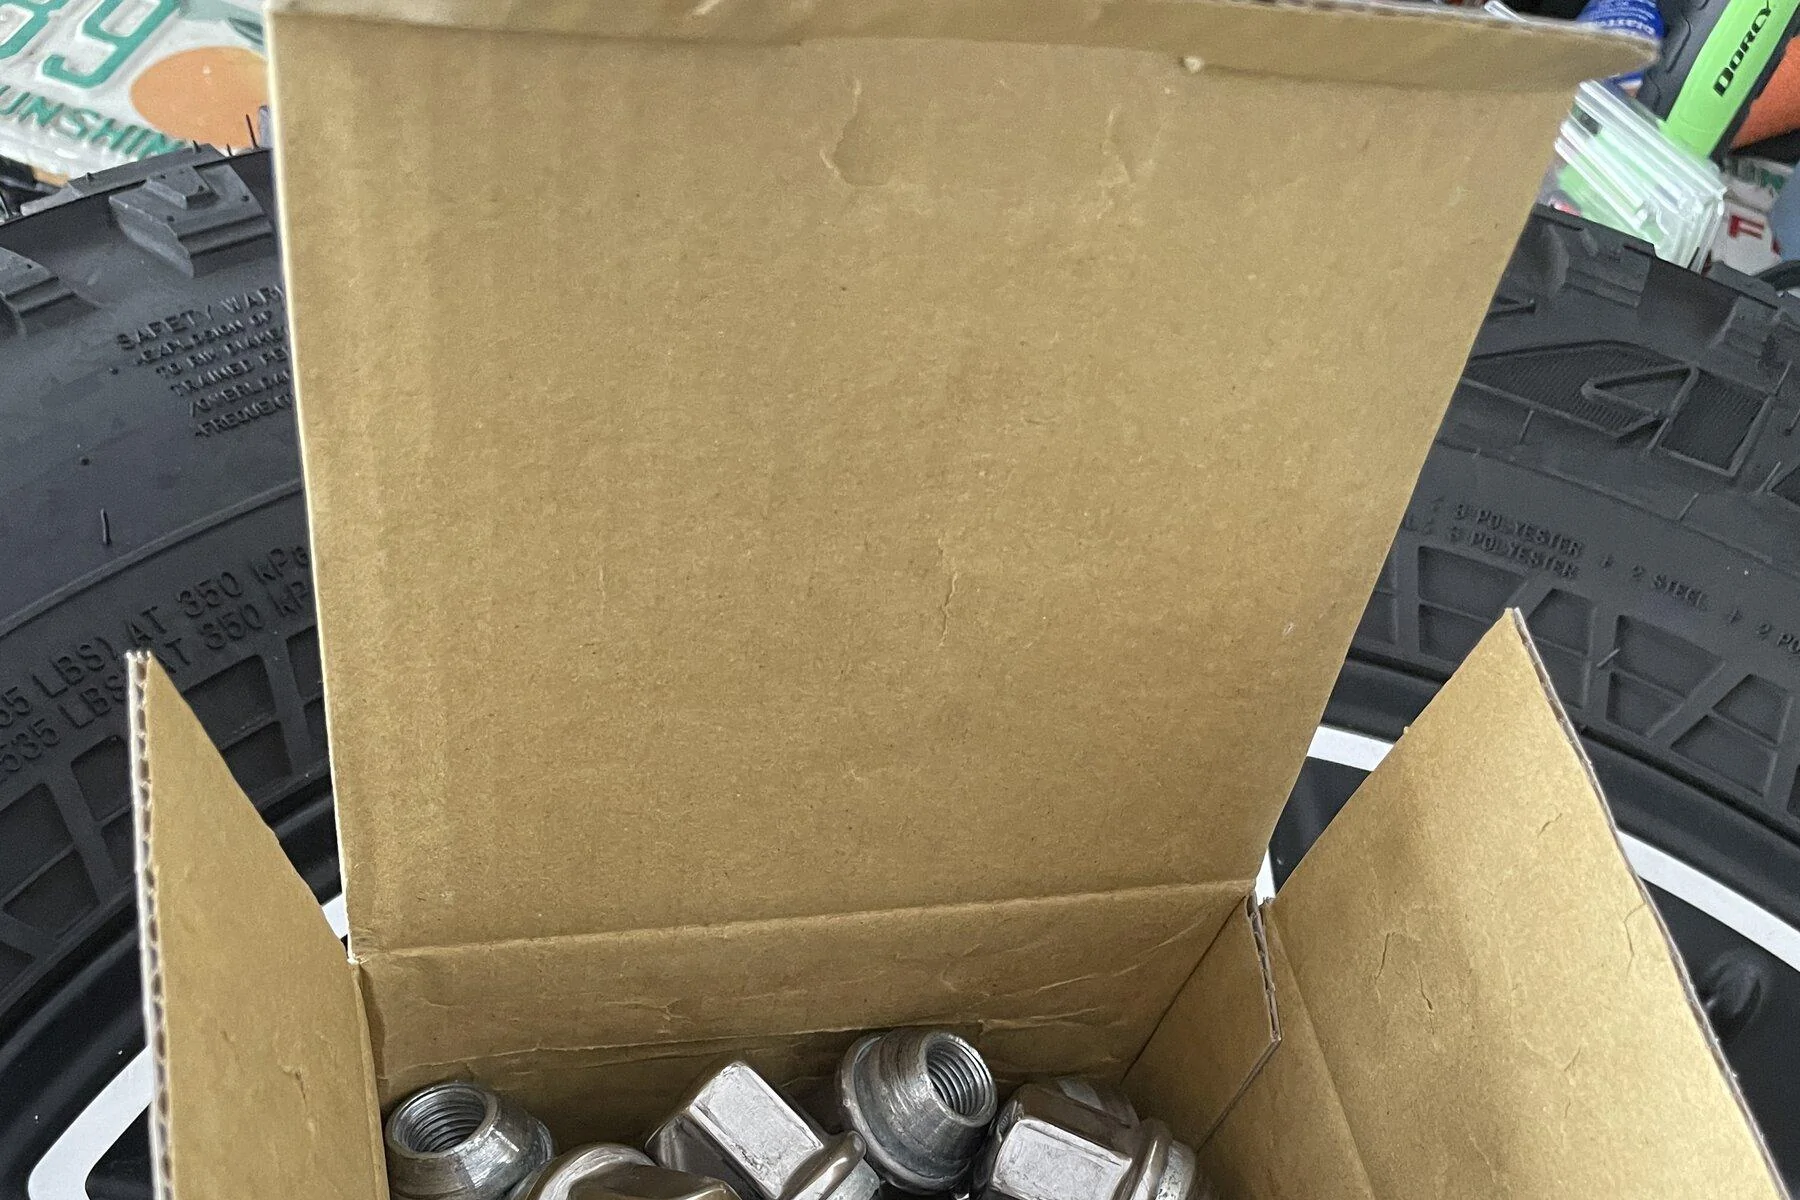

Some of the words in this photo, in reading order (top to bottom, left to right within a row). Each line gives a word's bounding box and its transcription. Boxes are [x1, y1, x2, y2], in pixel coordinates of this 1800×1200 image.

[1469, 531, 1581, 580] POLYESTER
[1477, 508, 1585, 559] POLYESTER
[124, 606, 168, 650] AT
[178, 570, 243, 619] 350
[200, 603, 263, 651] 350
